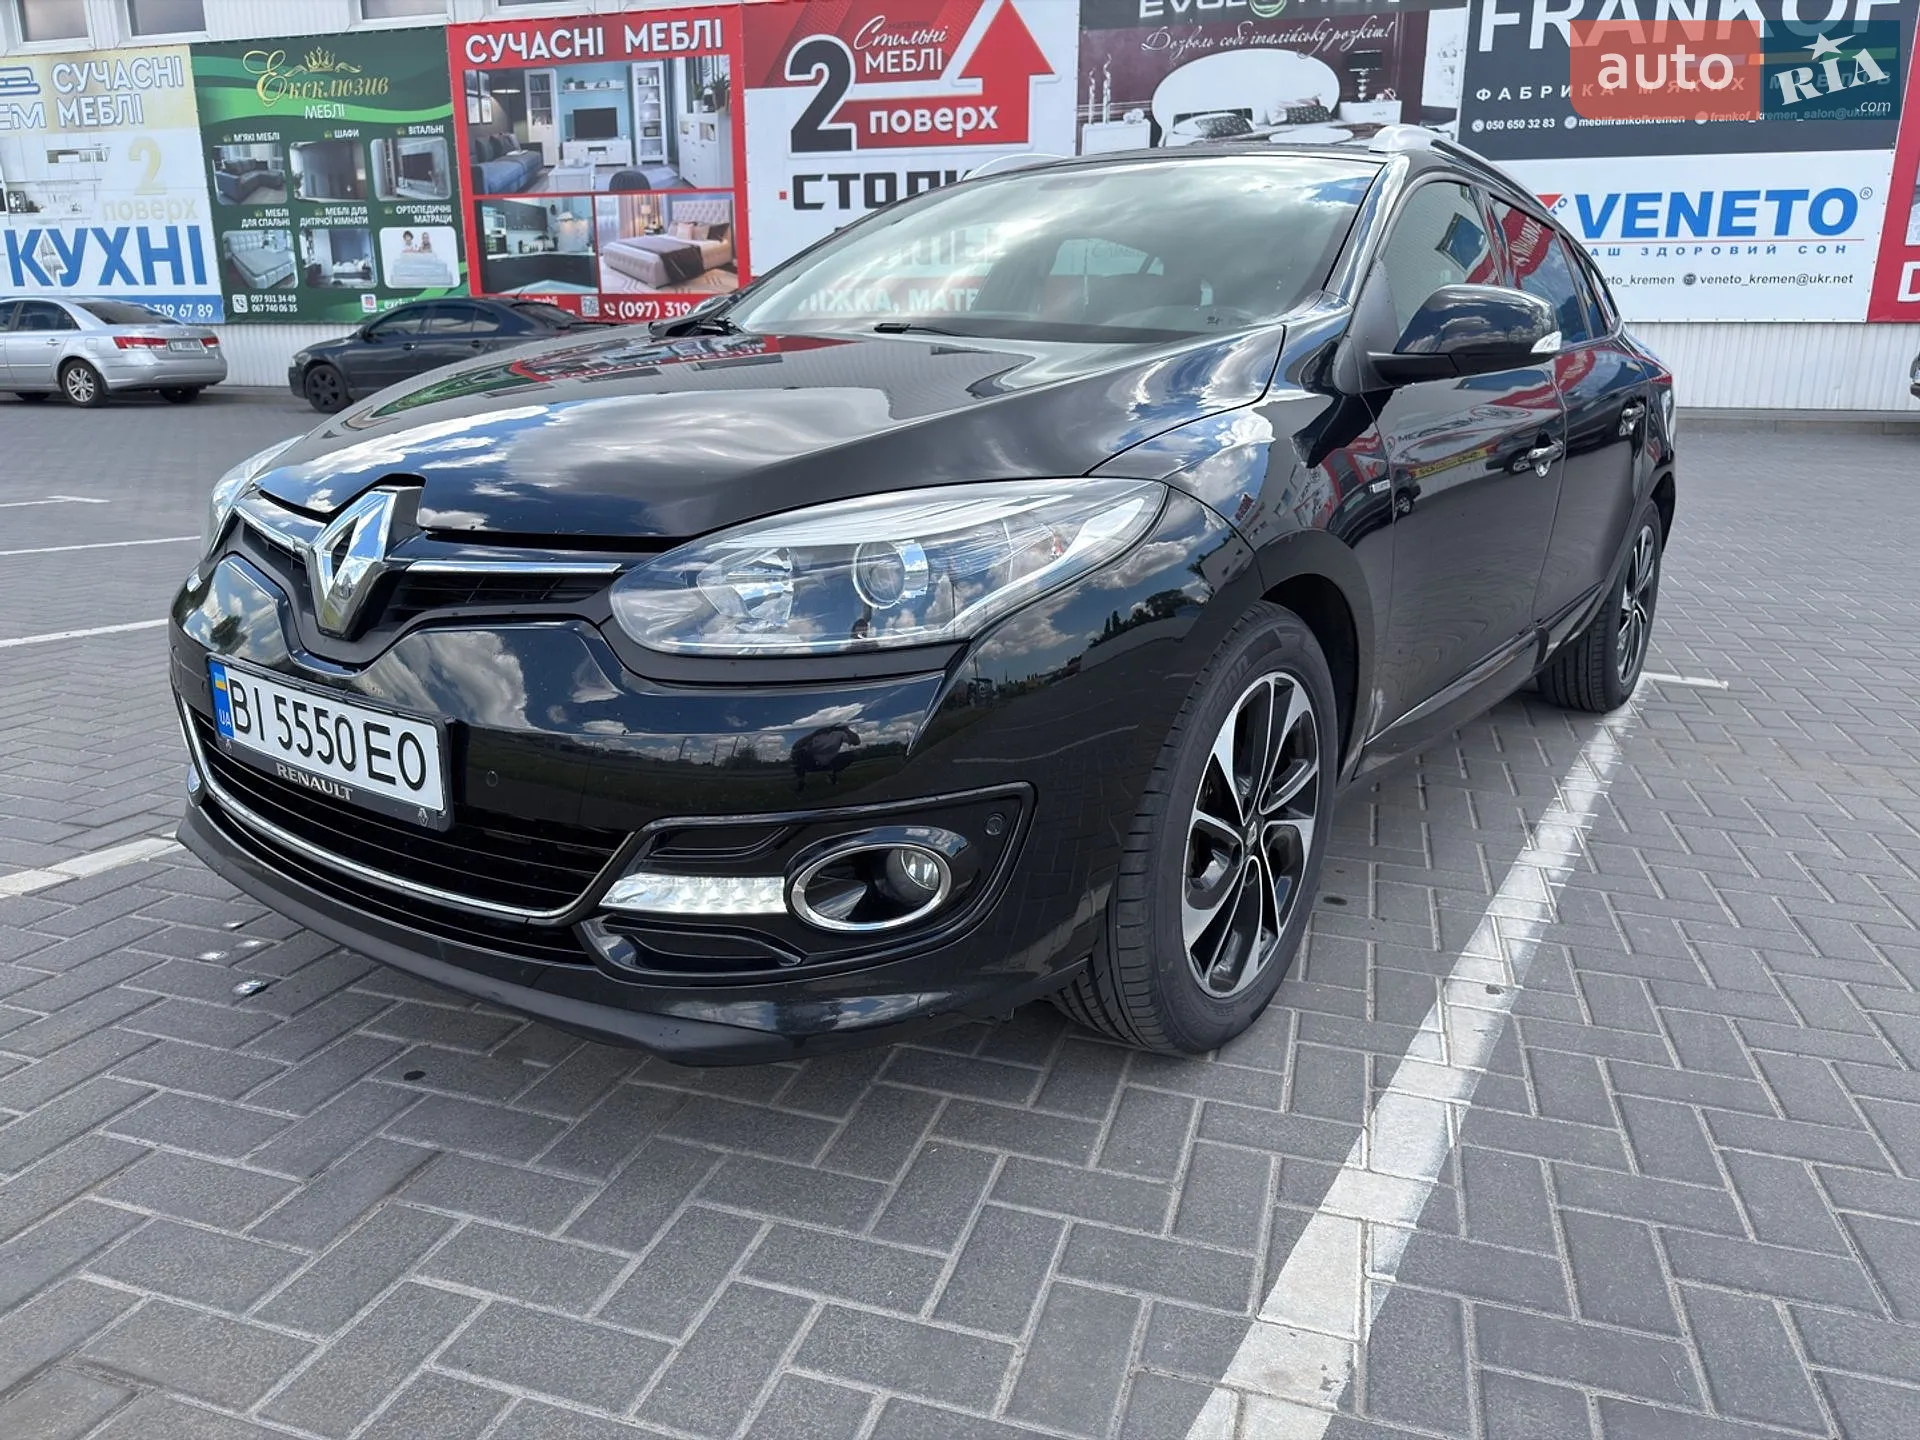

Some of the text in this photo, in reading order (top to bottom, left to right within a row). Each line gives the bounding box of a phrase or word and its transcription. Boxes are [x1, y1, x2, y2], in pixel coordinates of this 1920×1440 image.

[464, 19, 722, 64] СУЧАСНІ МЕБЛІ
[853, 15, 948, 50] Стильні
[1479, 0, 1900, 52] FRANKOF
[51, 56, 184, 94] СУЧАСНІ
[243, 50, 389, 107] Ексклюзив
[865, 47, 942, 74] МЕБЛІ
[56, 93, 145, 129] МЕБЛІ
[305, 104, 345, 119] МЕБЛІ
[786, 36, 998, 155] 2 поверх
[1486, 120, 1505, 130] 050
[1506, 119, 1525, 130] 650
[1527, 118, 1541, 129] 32
[128, 136, 167, 196] 2
[103, 198, 199, 225] поверх
[1574, 187, 1859, 240] VENETO
[4, 225, 207, 287] КУХНІ
[1590, 244, 1847, 257] АШ ЗДОРОВИЙ СОН
[1700, 271, 1854, 288] veneto_kremen@ukr.net
[178, 303, 194, 318] 67
[197, 303, 214, 318] 89
[618, 301, 692, 318] (097) 319
[218, 710, 232, 728] UA
[228, 677, 427, 791] BI 5550 EO
[275, 762, 353, 801] RENAULT
